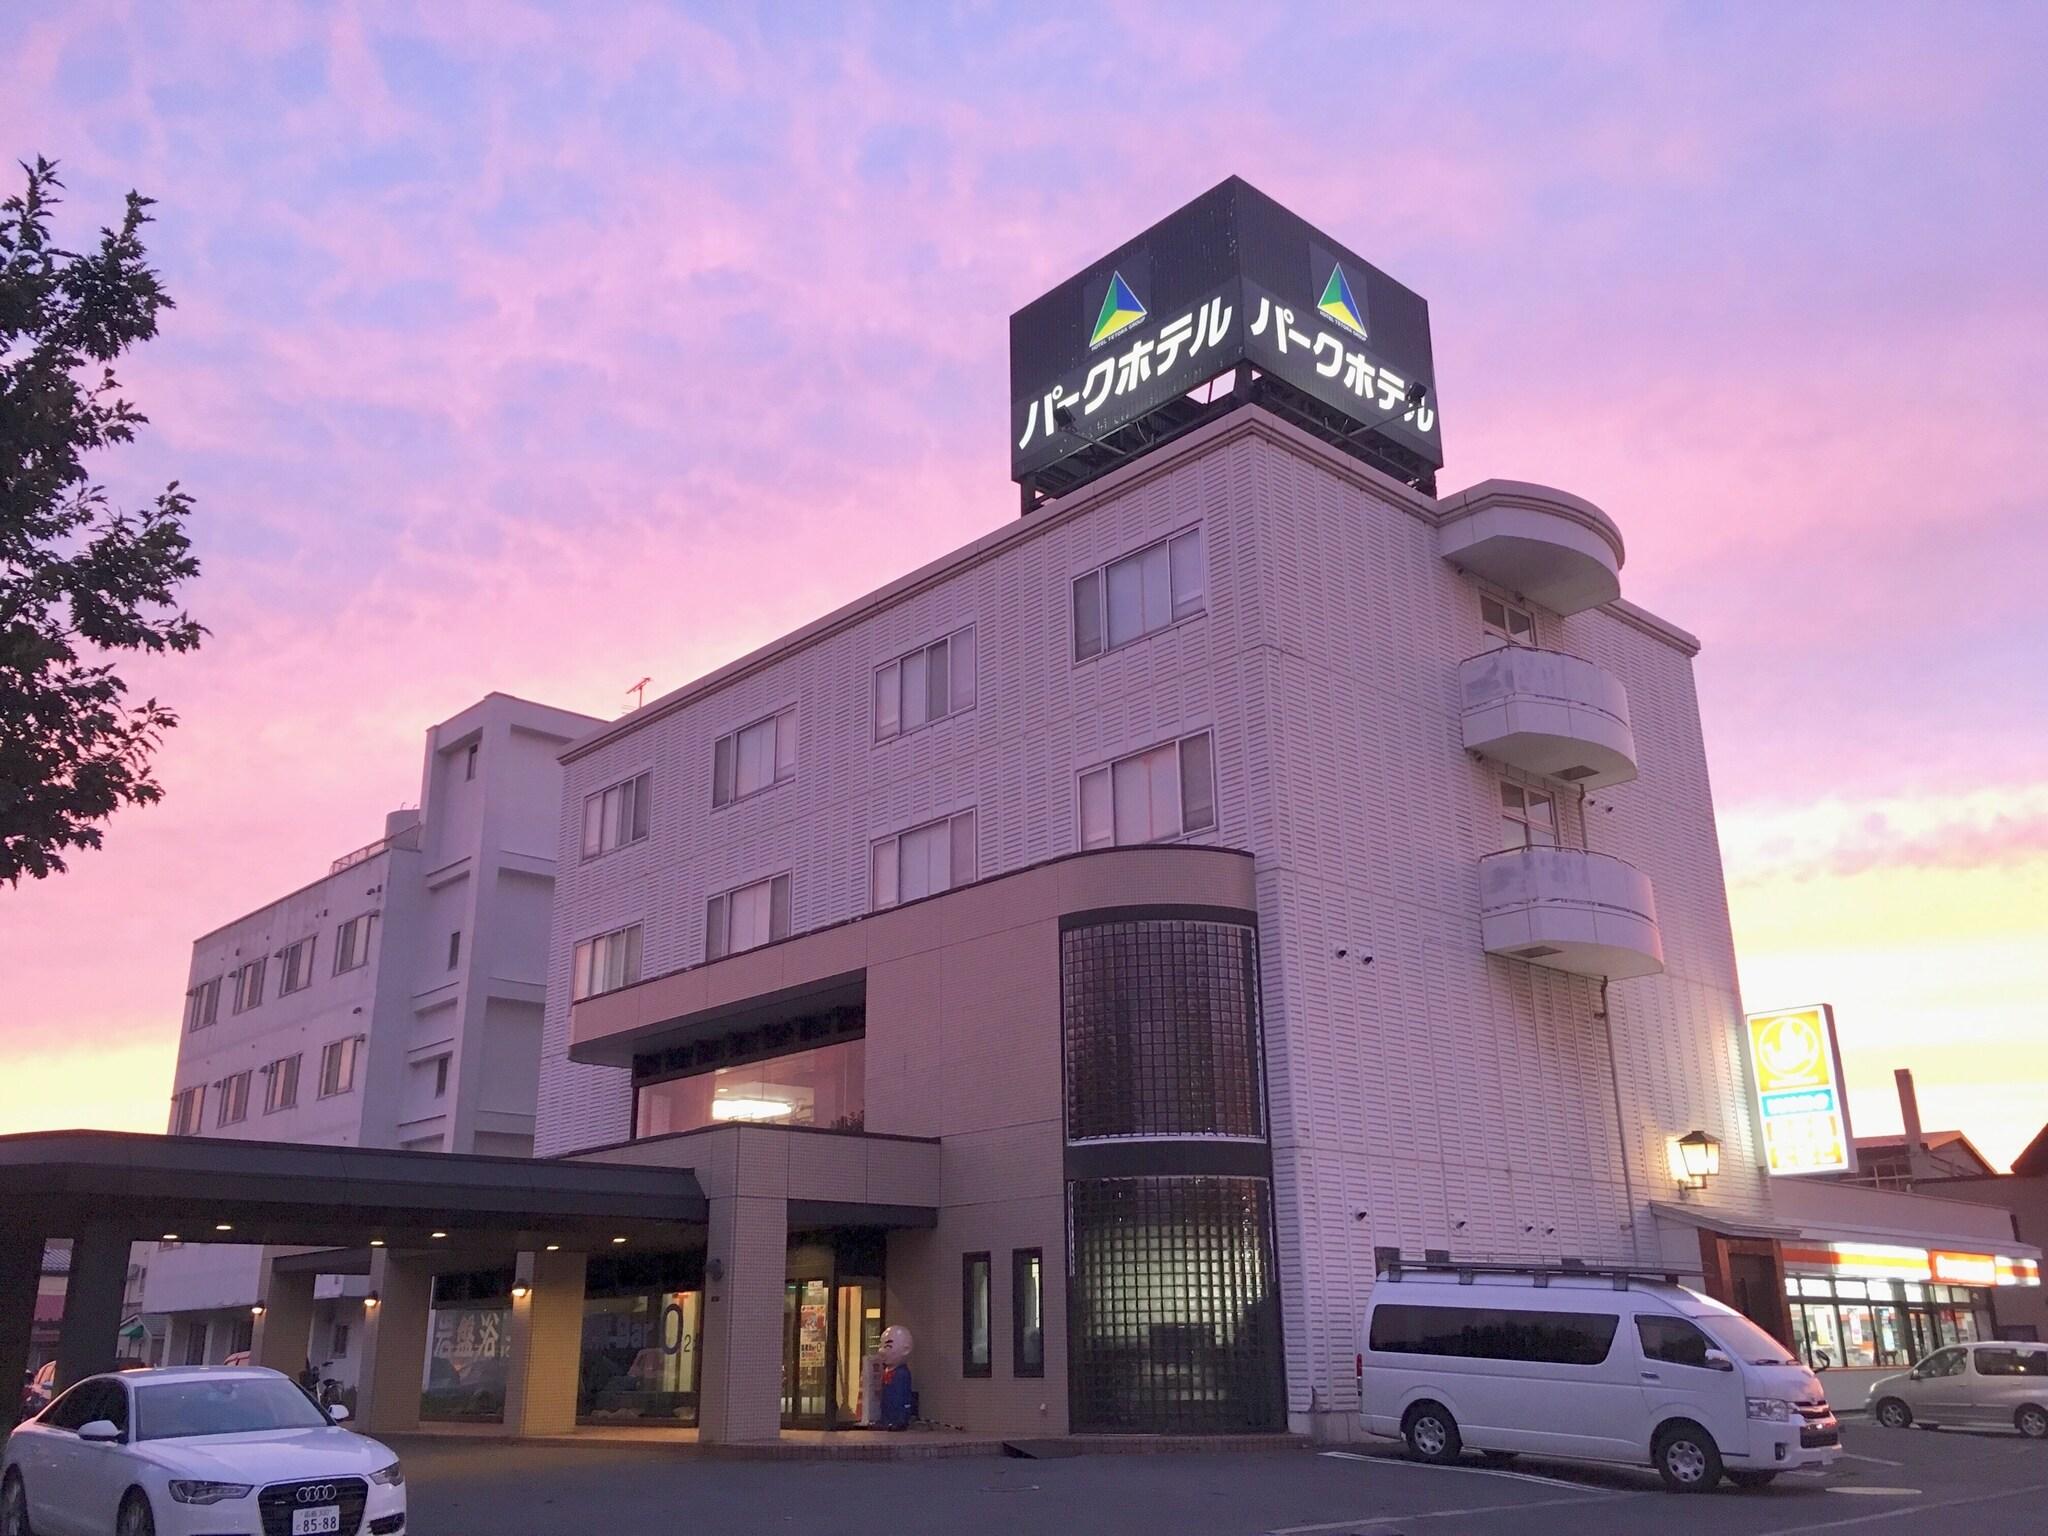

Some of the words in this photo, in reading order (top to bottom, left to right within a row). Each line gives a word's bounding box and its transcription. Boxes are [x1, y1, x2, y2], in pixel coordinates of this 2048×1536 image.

[1018, 296, 1233, 450] パークホテル
[303, 1515, 337, 1533] 85-88
